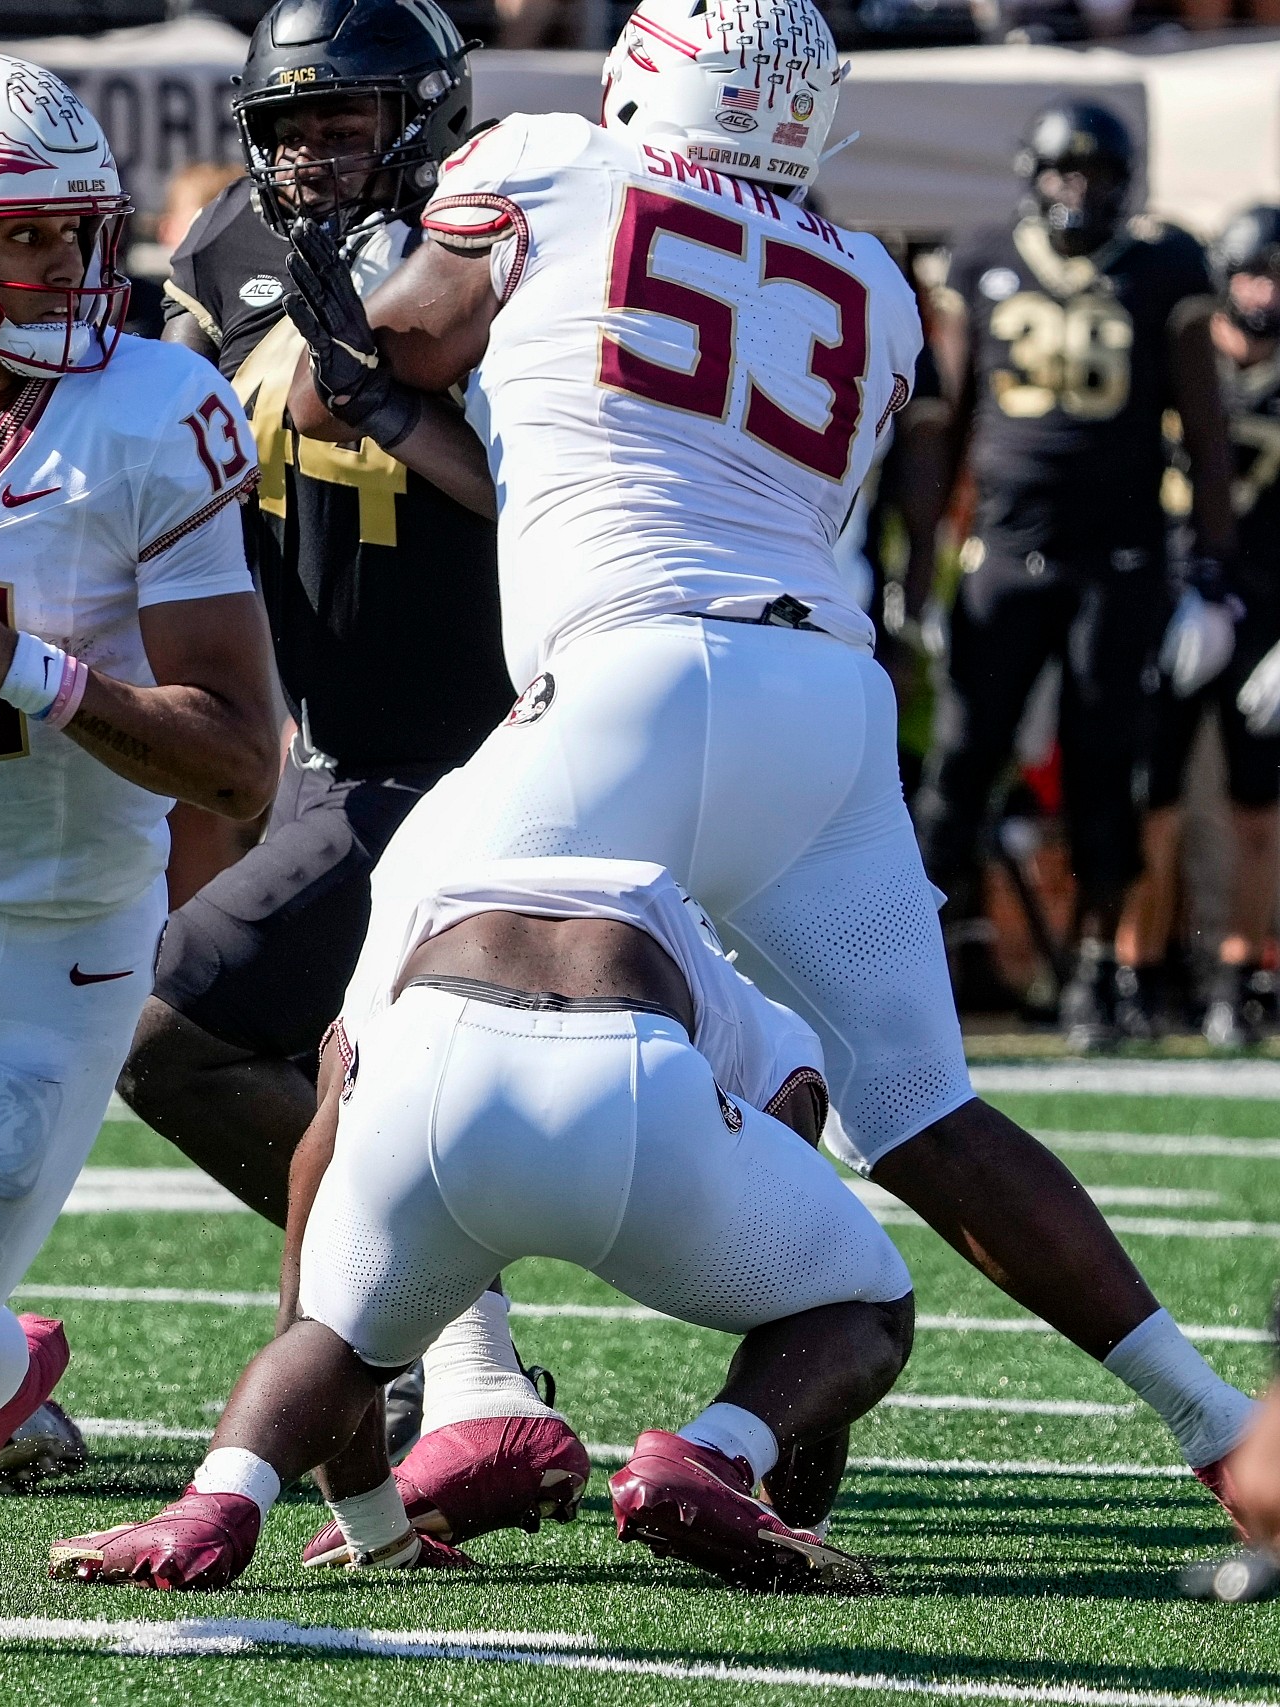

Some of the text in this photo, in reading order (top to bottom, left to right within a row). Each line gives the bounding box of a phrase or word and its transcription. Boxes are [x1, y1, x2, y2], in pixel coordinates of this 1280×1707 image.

[280, 67, 316, 84] DEACS
[687, 145, 810, 179] FLORIDA STATE
[67, 178, 107, 193] NOLES
[246, 283, 280, 296] ACC
[594, 184, 870, 486] 53
[178, 391, 249, 495] 13
